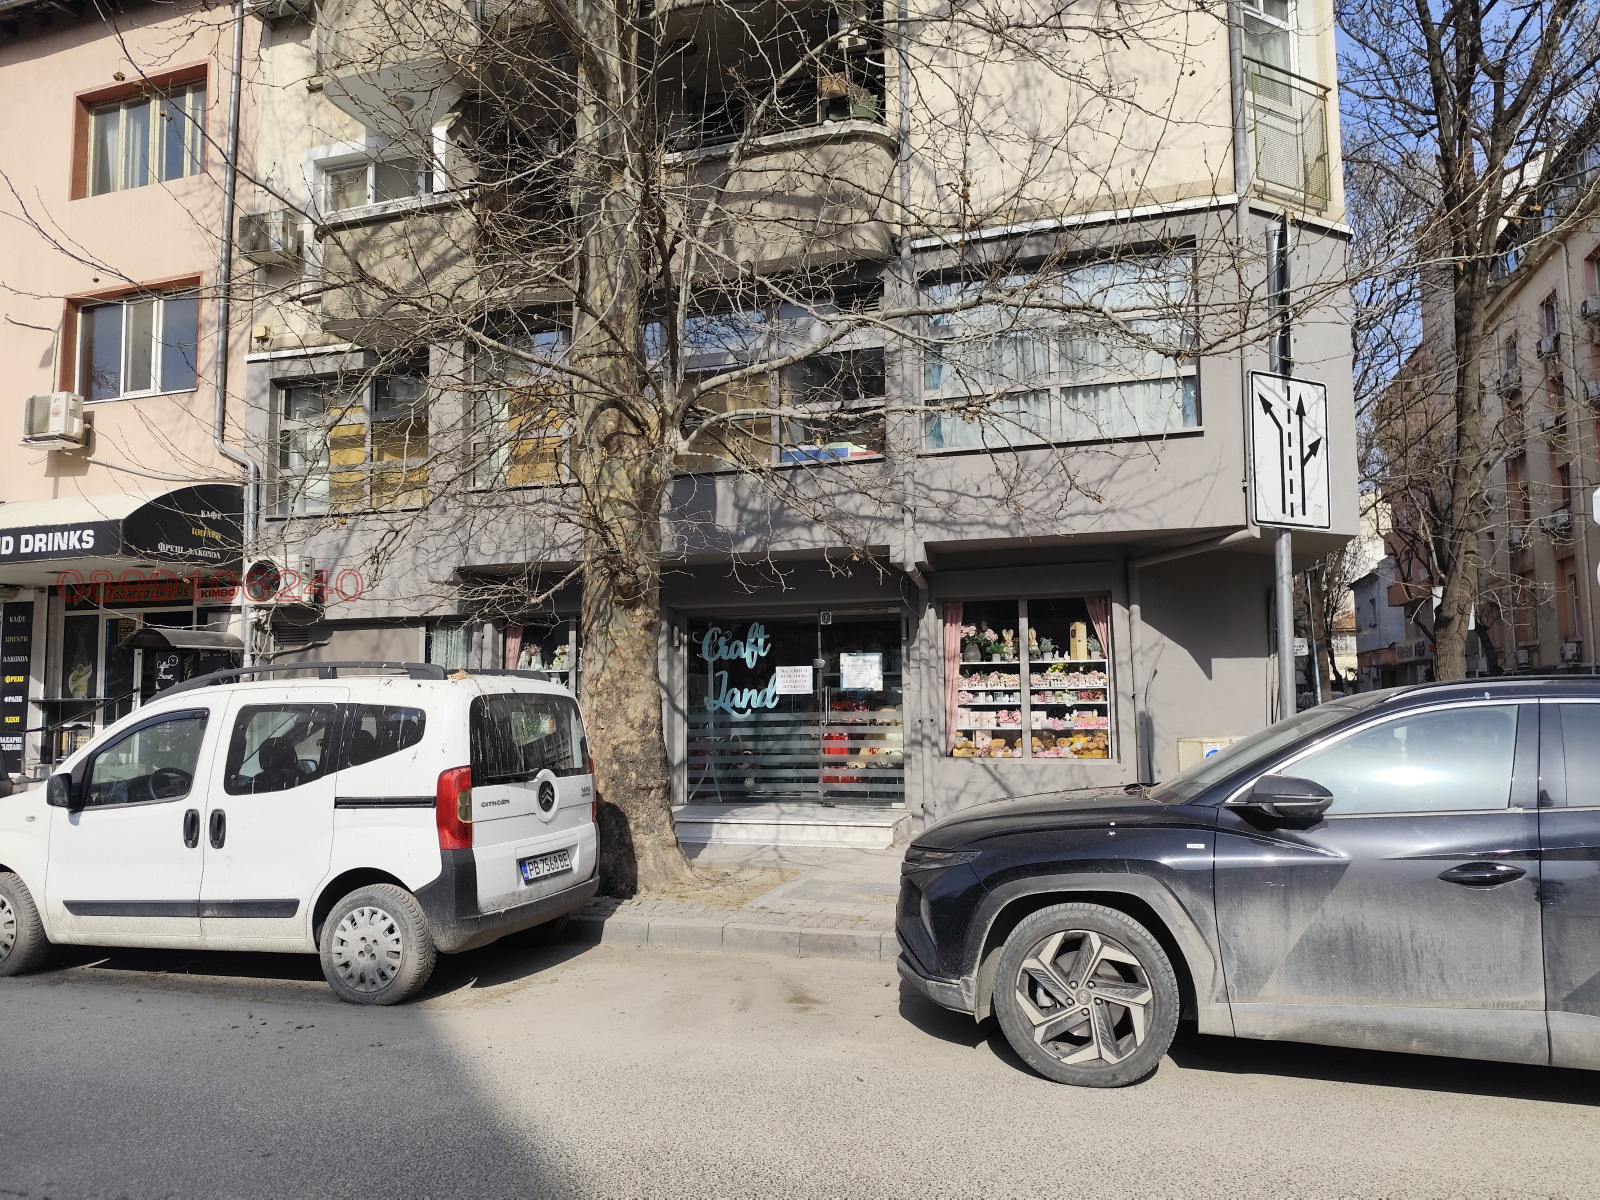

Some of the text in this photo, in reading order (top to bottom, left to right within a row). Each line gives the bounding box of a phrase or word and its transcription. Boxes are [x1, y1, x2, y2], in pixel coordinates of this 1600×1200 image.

[0, 529, 95, 555] D DRINKS
[201, 588, 236, 598] KIMBO
[9, 615, 26, 623] КАФЕ
[5, 635, 28, 643] ЦИГАРИ
[702, 621, 772, 670] Craft
[2, 655, 29, 663] АЛКОХОЛ
[5, 675, 25, 684] ФРЕШ
[4, 695, 23, 703] ФРАПЕ
[706, 670, 780, 719] Land
[539, 856, 560, 874] 7568
